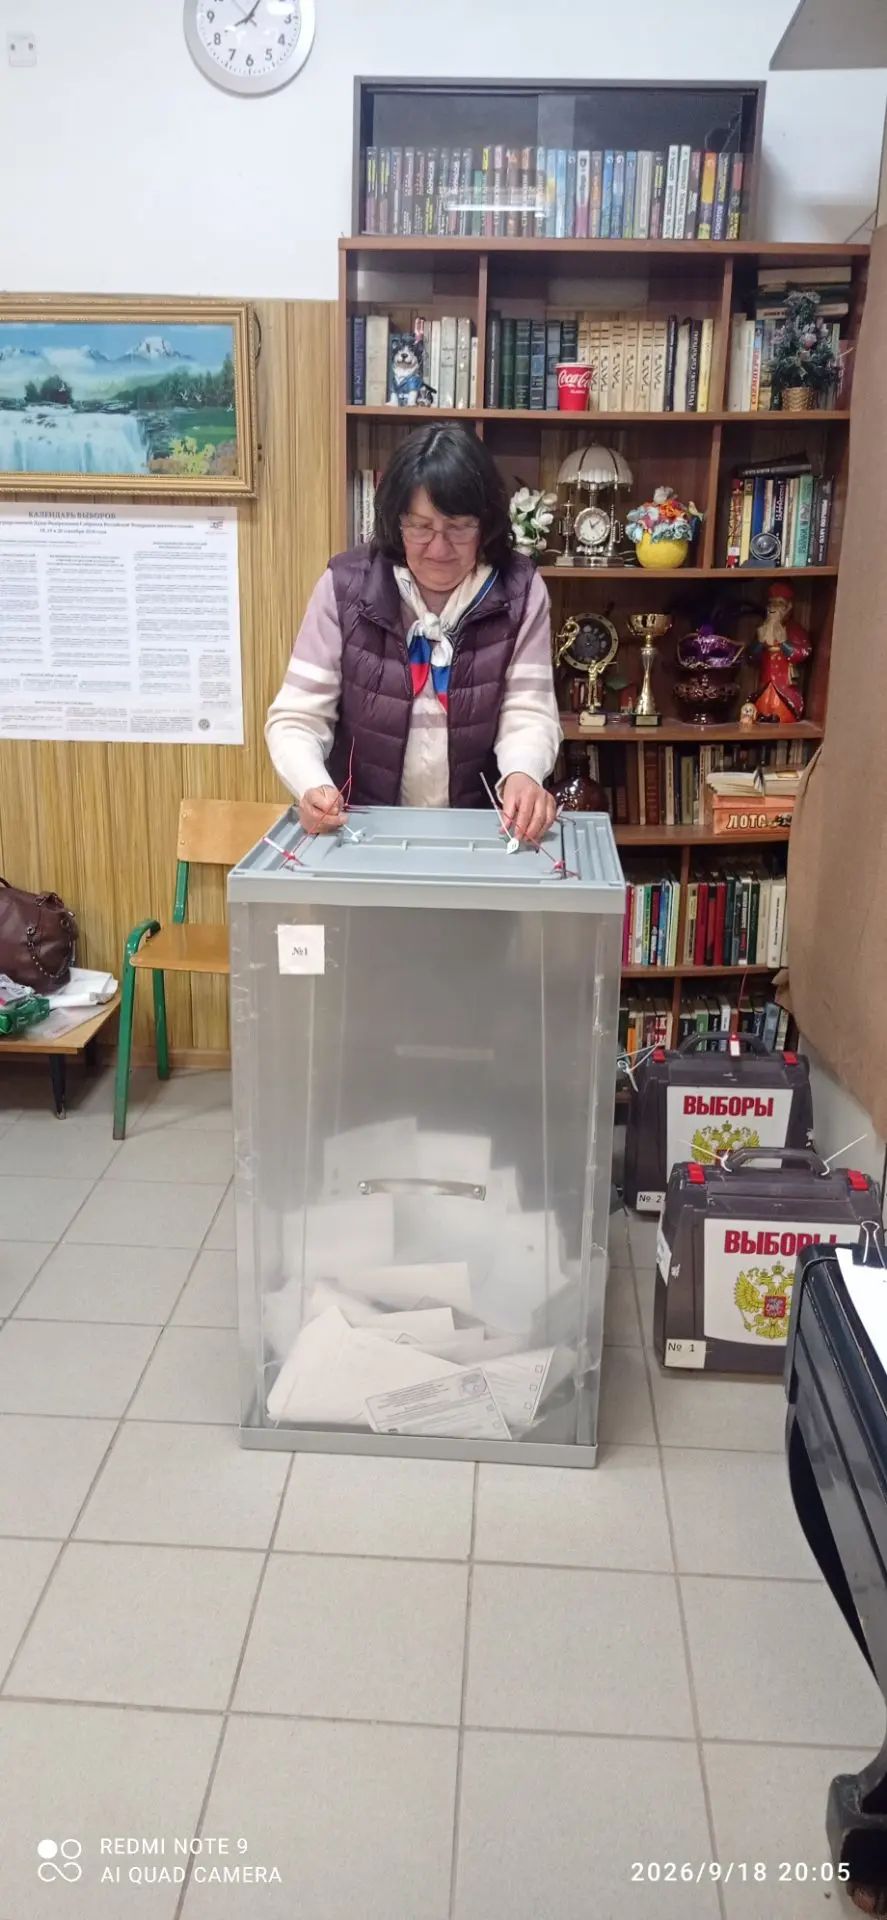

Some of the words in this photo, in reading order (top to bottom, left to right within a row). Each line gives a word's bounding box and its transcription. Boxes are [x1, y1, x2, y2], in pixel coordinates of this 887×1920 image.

[207, 10, 215, 23] 9
[284, 13, 292, 24] 3
[214, 32, 221, 45] 8
[277, 33, 286, 45] 4
[228, 48, 236, 61] 7
[245, 54, 254, 67] 6
[265, 48, 273, 61] 5
[28, 511, 76, 519] КАЛЕНДАРЬ
[77, 512, 116, 520] ВЫБОРОВ
[291, 946, 308, 956] №1
[683, 1095, 774, 1117] ВЫБОРЫ
[656, 1195, 662, 1203] 2
[689, 1343, 694, 1352] 1
